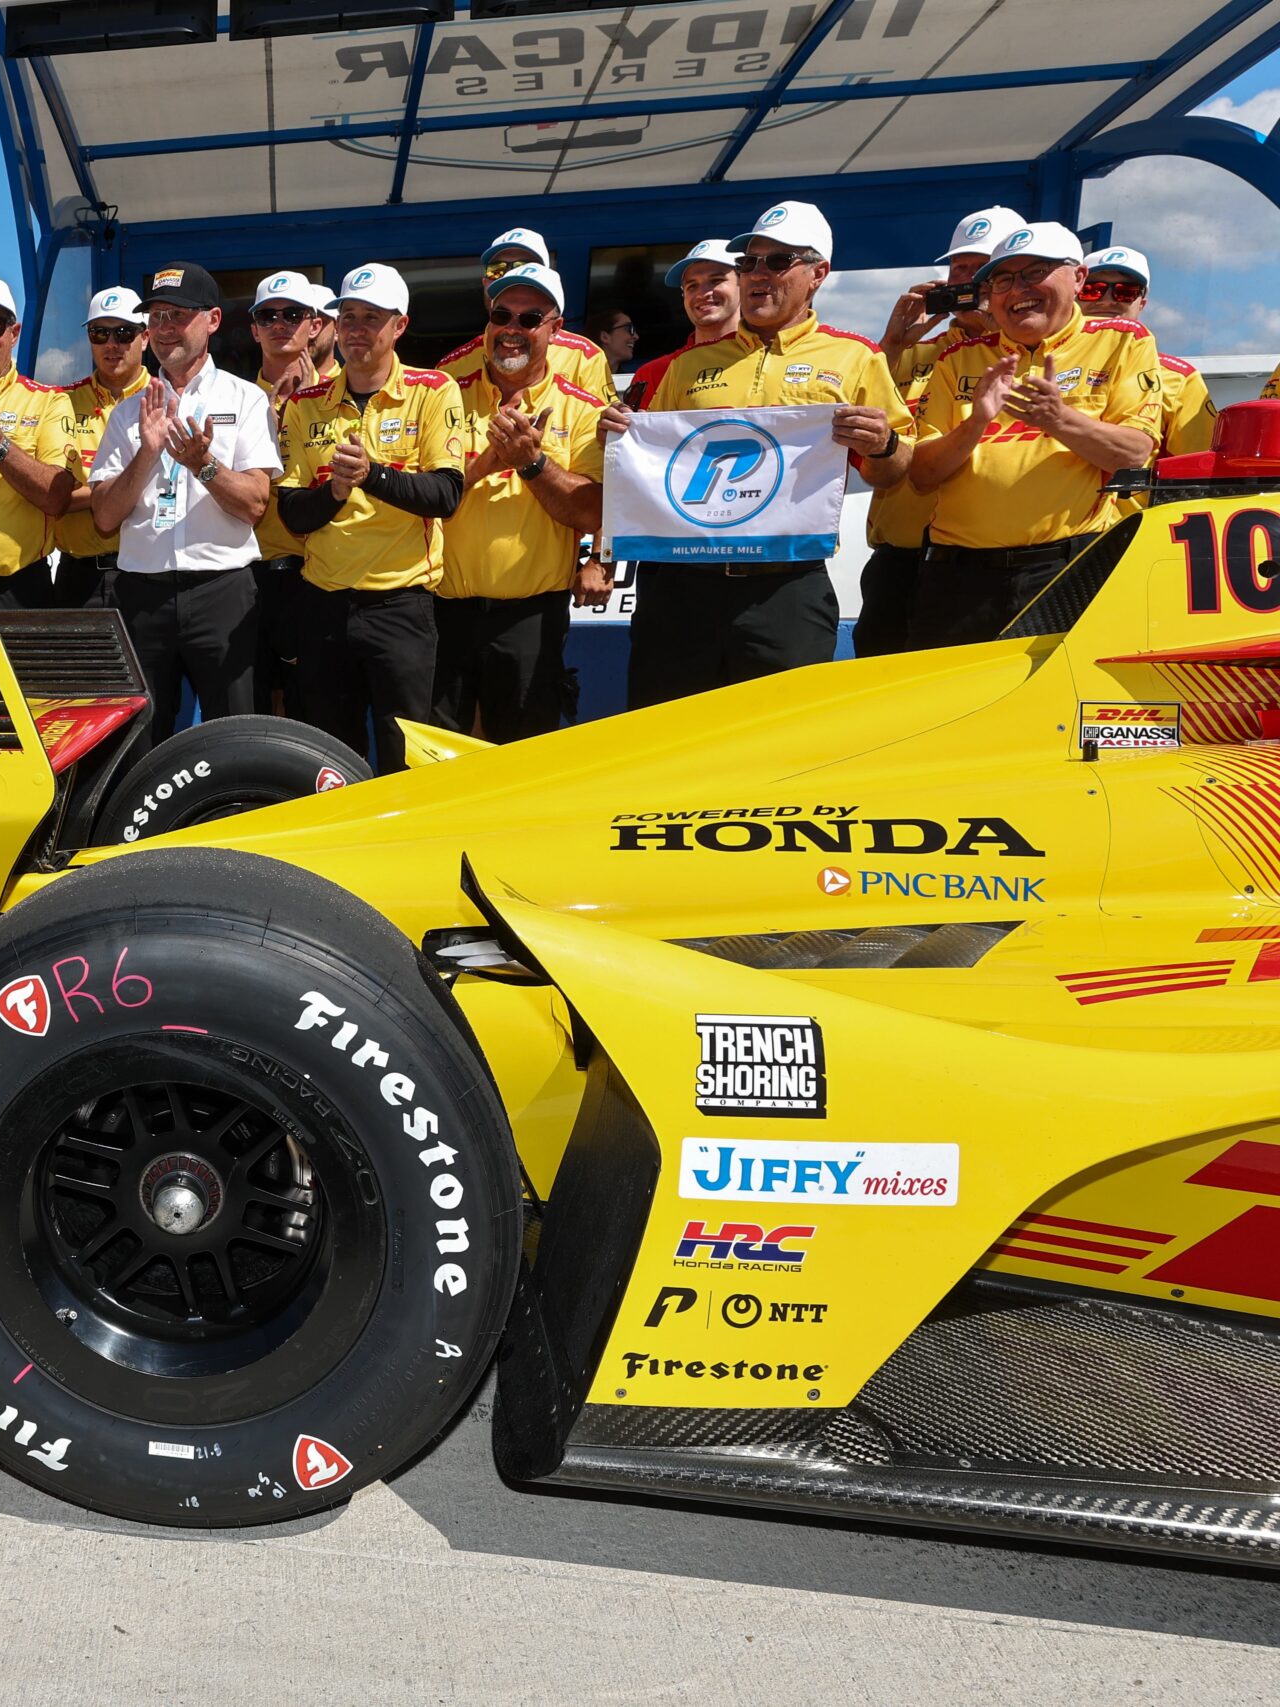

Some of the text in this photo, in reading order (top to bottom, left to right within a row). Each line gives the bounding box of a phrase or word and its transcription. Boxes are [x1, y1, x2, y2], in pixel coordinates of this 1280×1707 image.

[686, 382, 728, 396] HONDA
[739, 489, 762, 498] NTT
[706, 509, 732, 517] 2025
[672, 545, 763, 555] MILWAUKEE MILE
[1169, 508, 1280, 614] 10
[1095, 708, 1165, 721] DHL
[1084, 727, 1176, 740] CHIP GANASSI
[1084, 738, 1177, 747] ACING
[612, 805, 860, 822] POWERED by
[609, 817, 1046, 858] HONDA
[696, 1025, 816, 1065] TRENCH
[696, 1064, 817, 1098] SHORING
[704, 1098, 810, 1108] COMPANY
[292, 991, 468, 1299] Firestone
[863, 1171, 948, 1196] mixes
[673, 1219, 817, 1263] HRC
[673, 1259, 802, 1273] Honda RACING
[769, 1302, 828, 1323] NTT
[622, 1352, 825, 1381] Firestone
